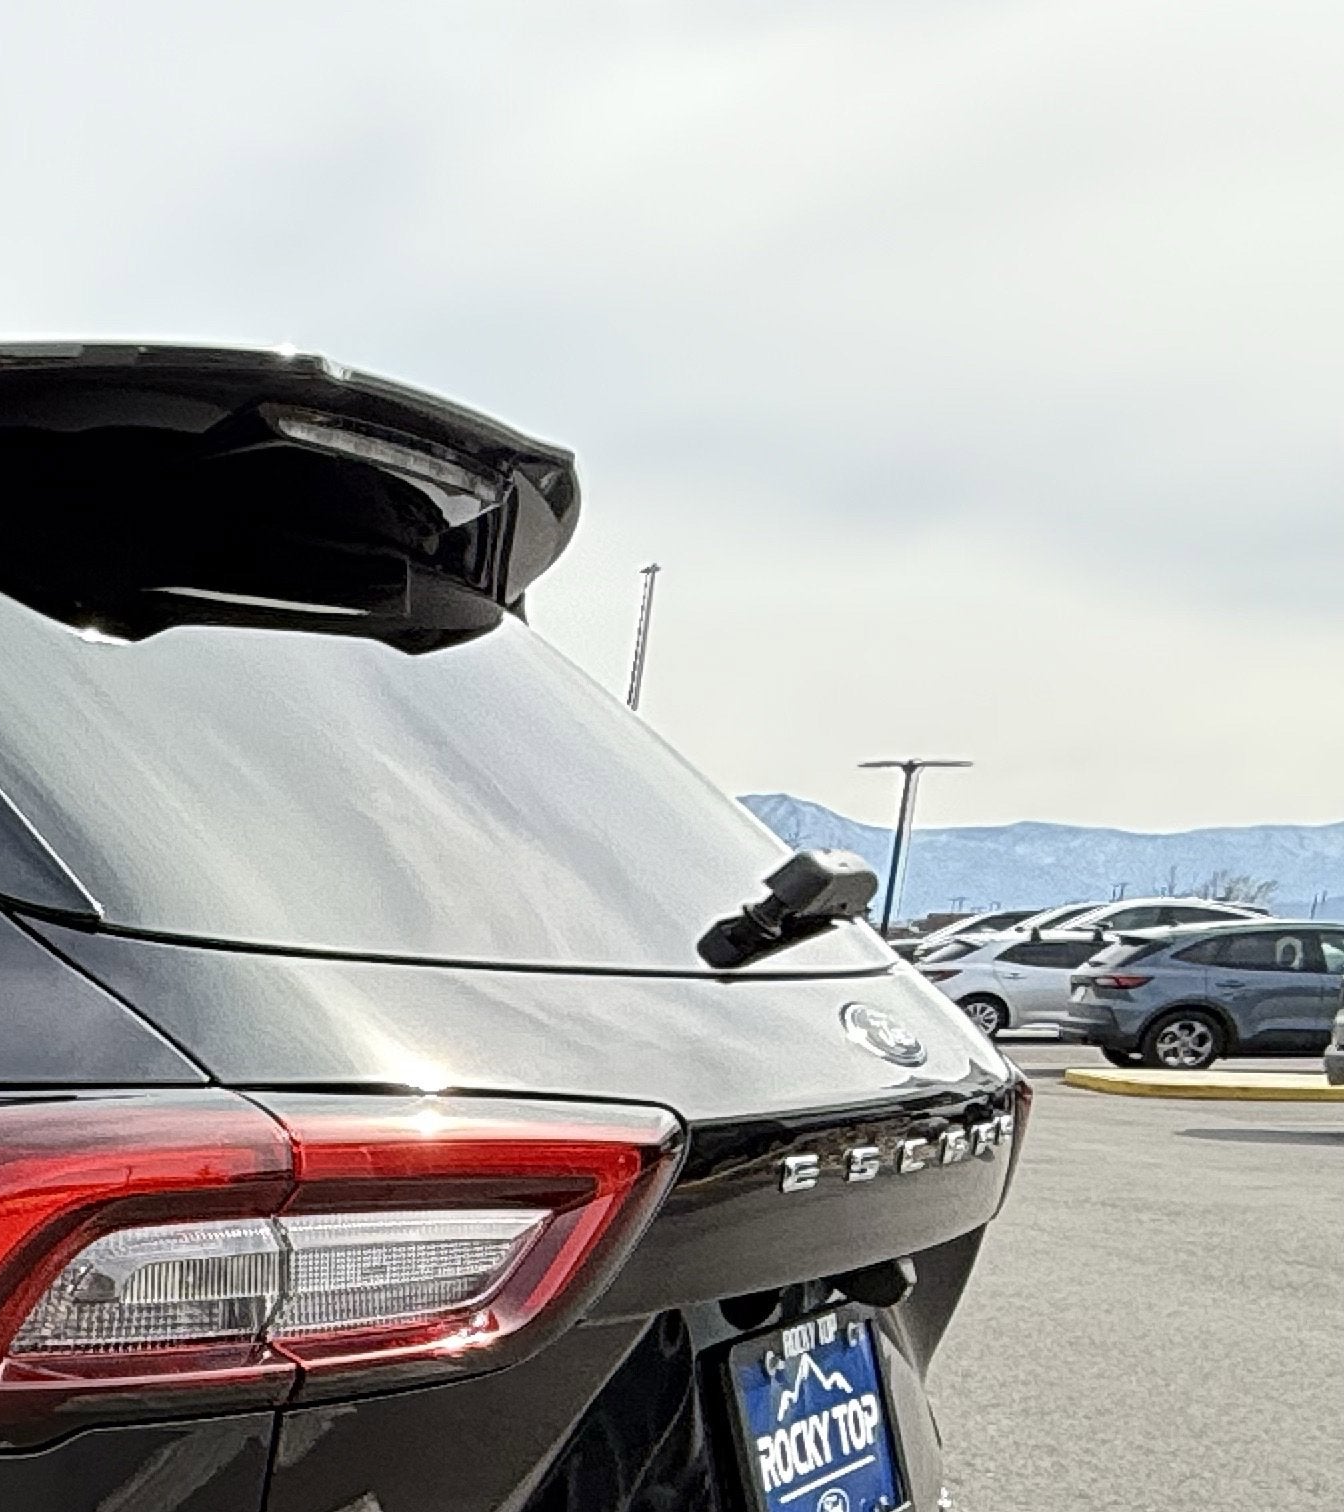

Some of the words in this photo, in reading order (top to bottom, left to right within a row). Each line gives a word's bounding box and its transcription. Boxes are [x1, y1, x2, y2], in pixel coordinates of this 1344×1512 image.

[782, 1322, 816, 1360] ROCKY
[816, 1312, 838, 1346] TOP
[756, 1410, 833, 1493] ROCKY
[832, 1394, 878, 1456] TOP
